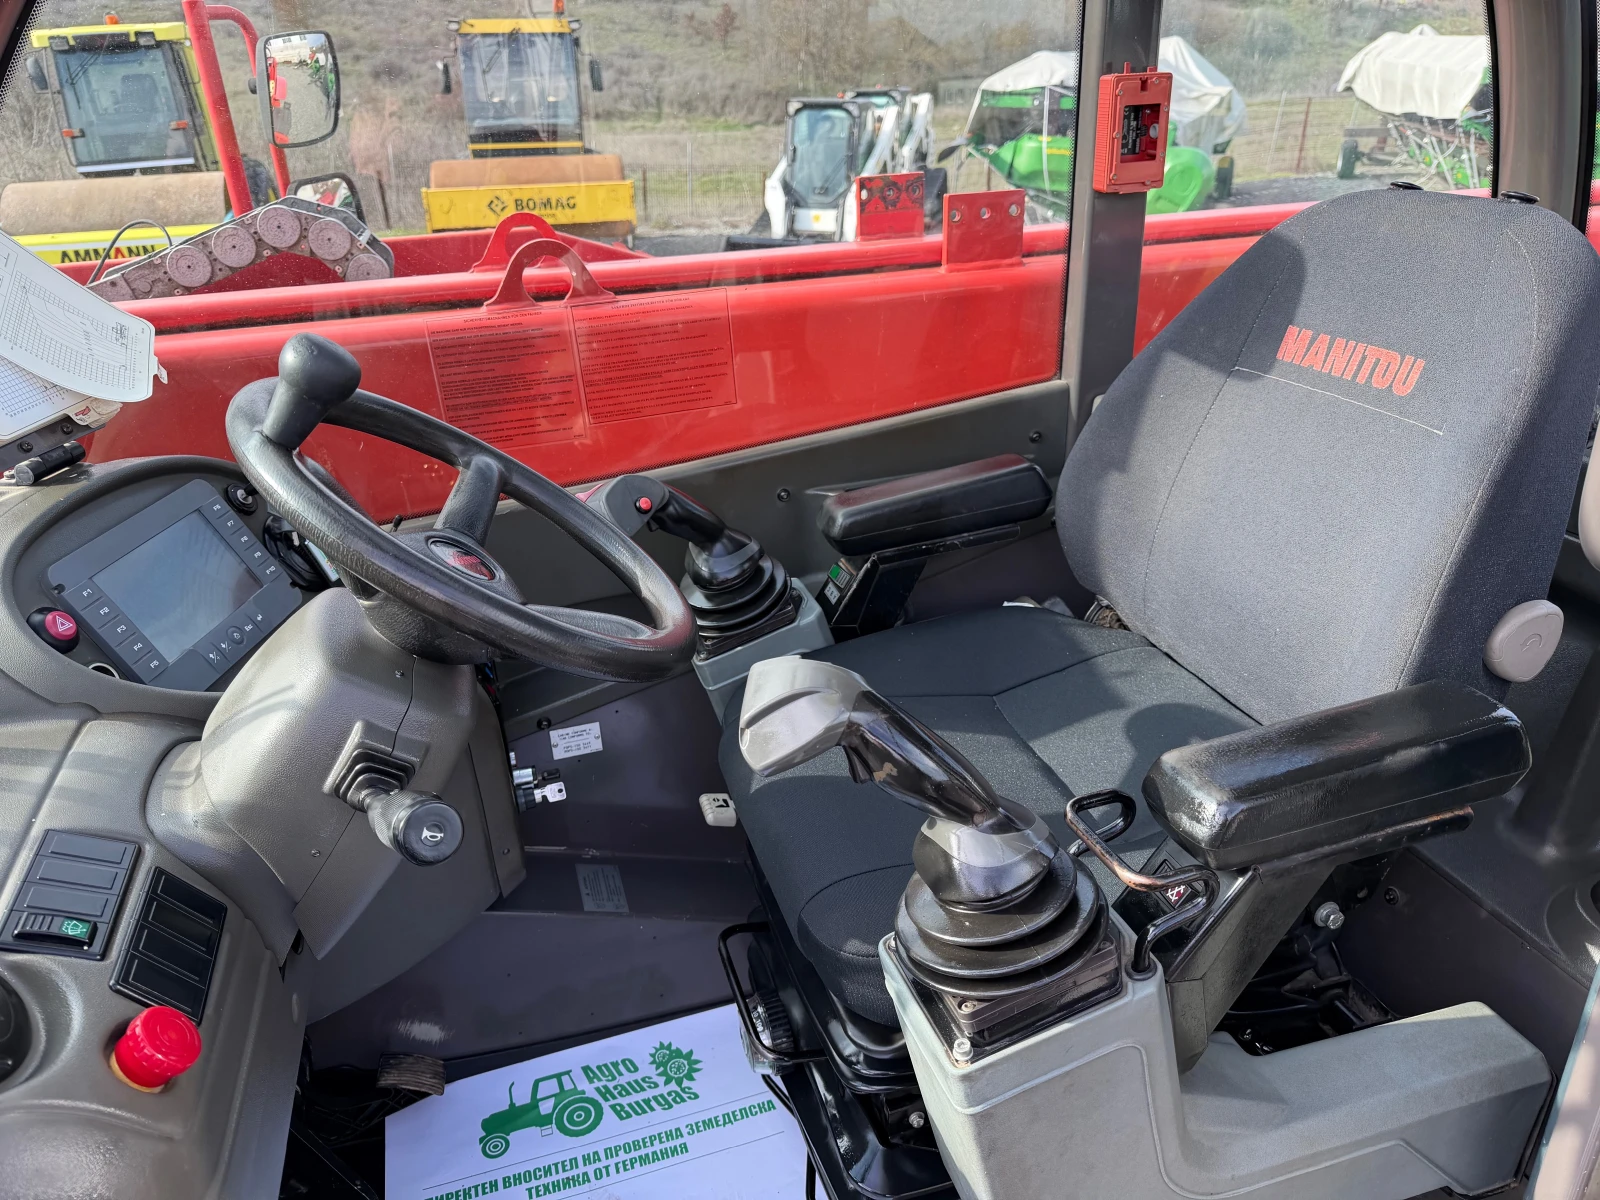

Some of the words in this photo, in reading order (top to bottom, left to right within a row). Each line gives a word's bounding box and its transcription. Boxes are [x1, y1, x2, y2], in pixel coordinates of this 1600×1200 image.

[515, 196, 576, 211] BOMAG
[61, 244, 155, 263] AMMANN
[1276, 325, 1426, 396] MANITOU
[226, 519, 235, 528] F7
[265, 565, 276, 575] F10
[82, 588, 93, 597] F1
[99, 606, 110, 615] F2
[116, 624, 127, 634] F3
[244, 623, 254, 632] Esc
[133, 641, 143, 651] F4
[149, 659, 160, 669] F5
[581, 1056, 639, 1085] Agro
[594, 1074, 660, 1103] Haus
[609, 1084, 701, 1122] Burgas
[424, 1178, 498, 1200] РЕКТЕН
[502, 1157, 580, 1192] ВНОСИТЕЛ
[582, 1150, 602, 1167] НА
[603, 1127, 685, 1163] ПРОВЕРЕНА
[687, 1100, 776, 1137] ЗЕМЕДЕЛСКА
[525, 1171, 591, 1200] ТЕХНИКА
[593, 1163, 612, 1183] ОТ
[614, 1141, 690, 1177] ГЕРМАНИЯ
